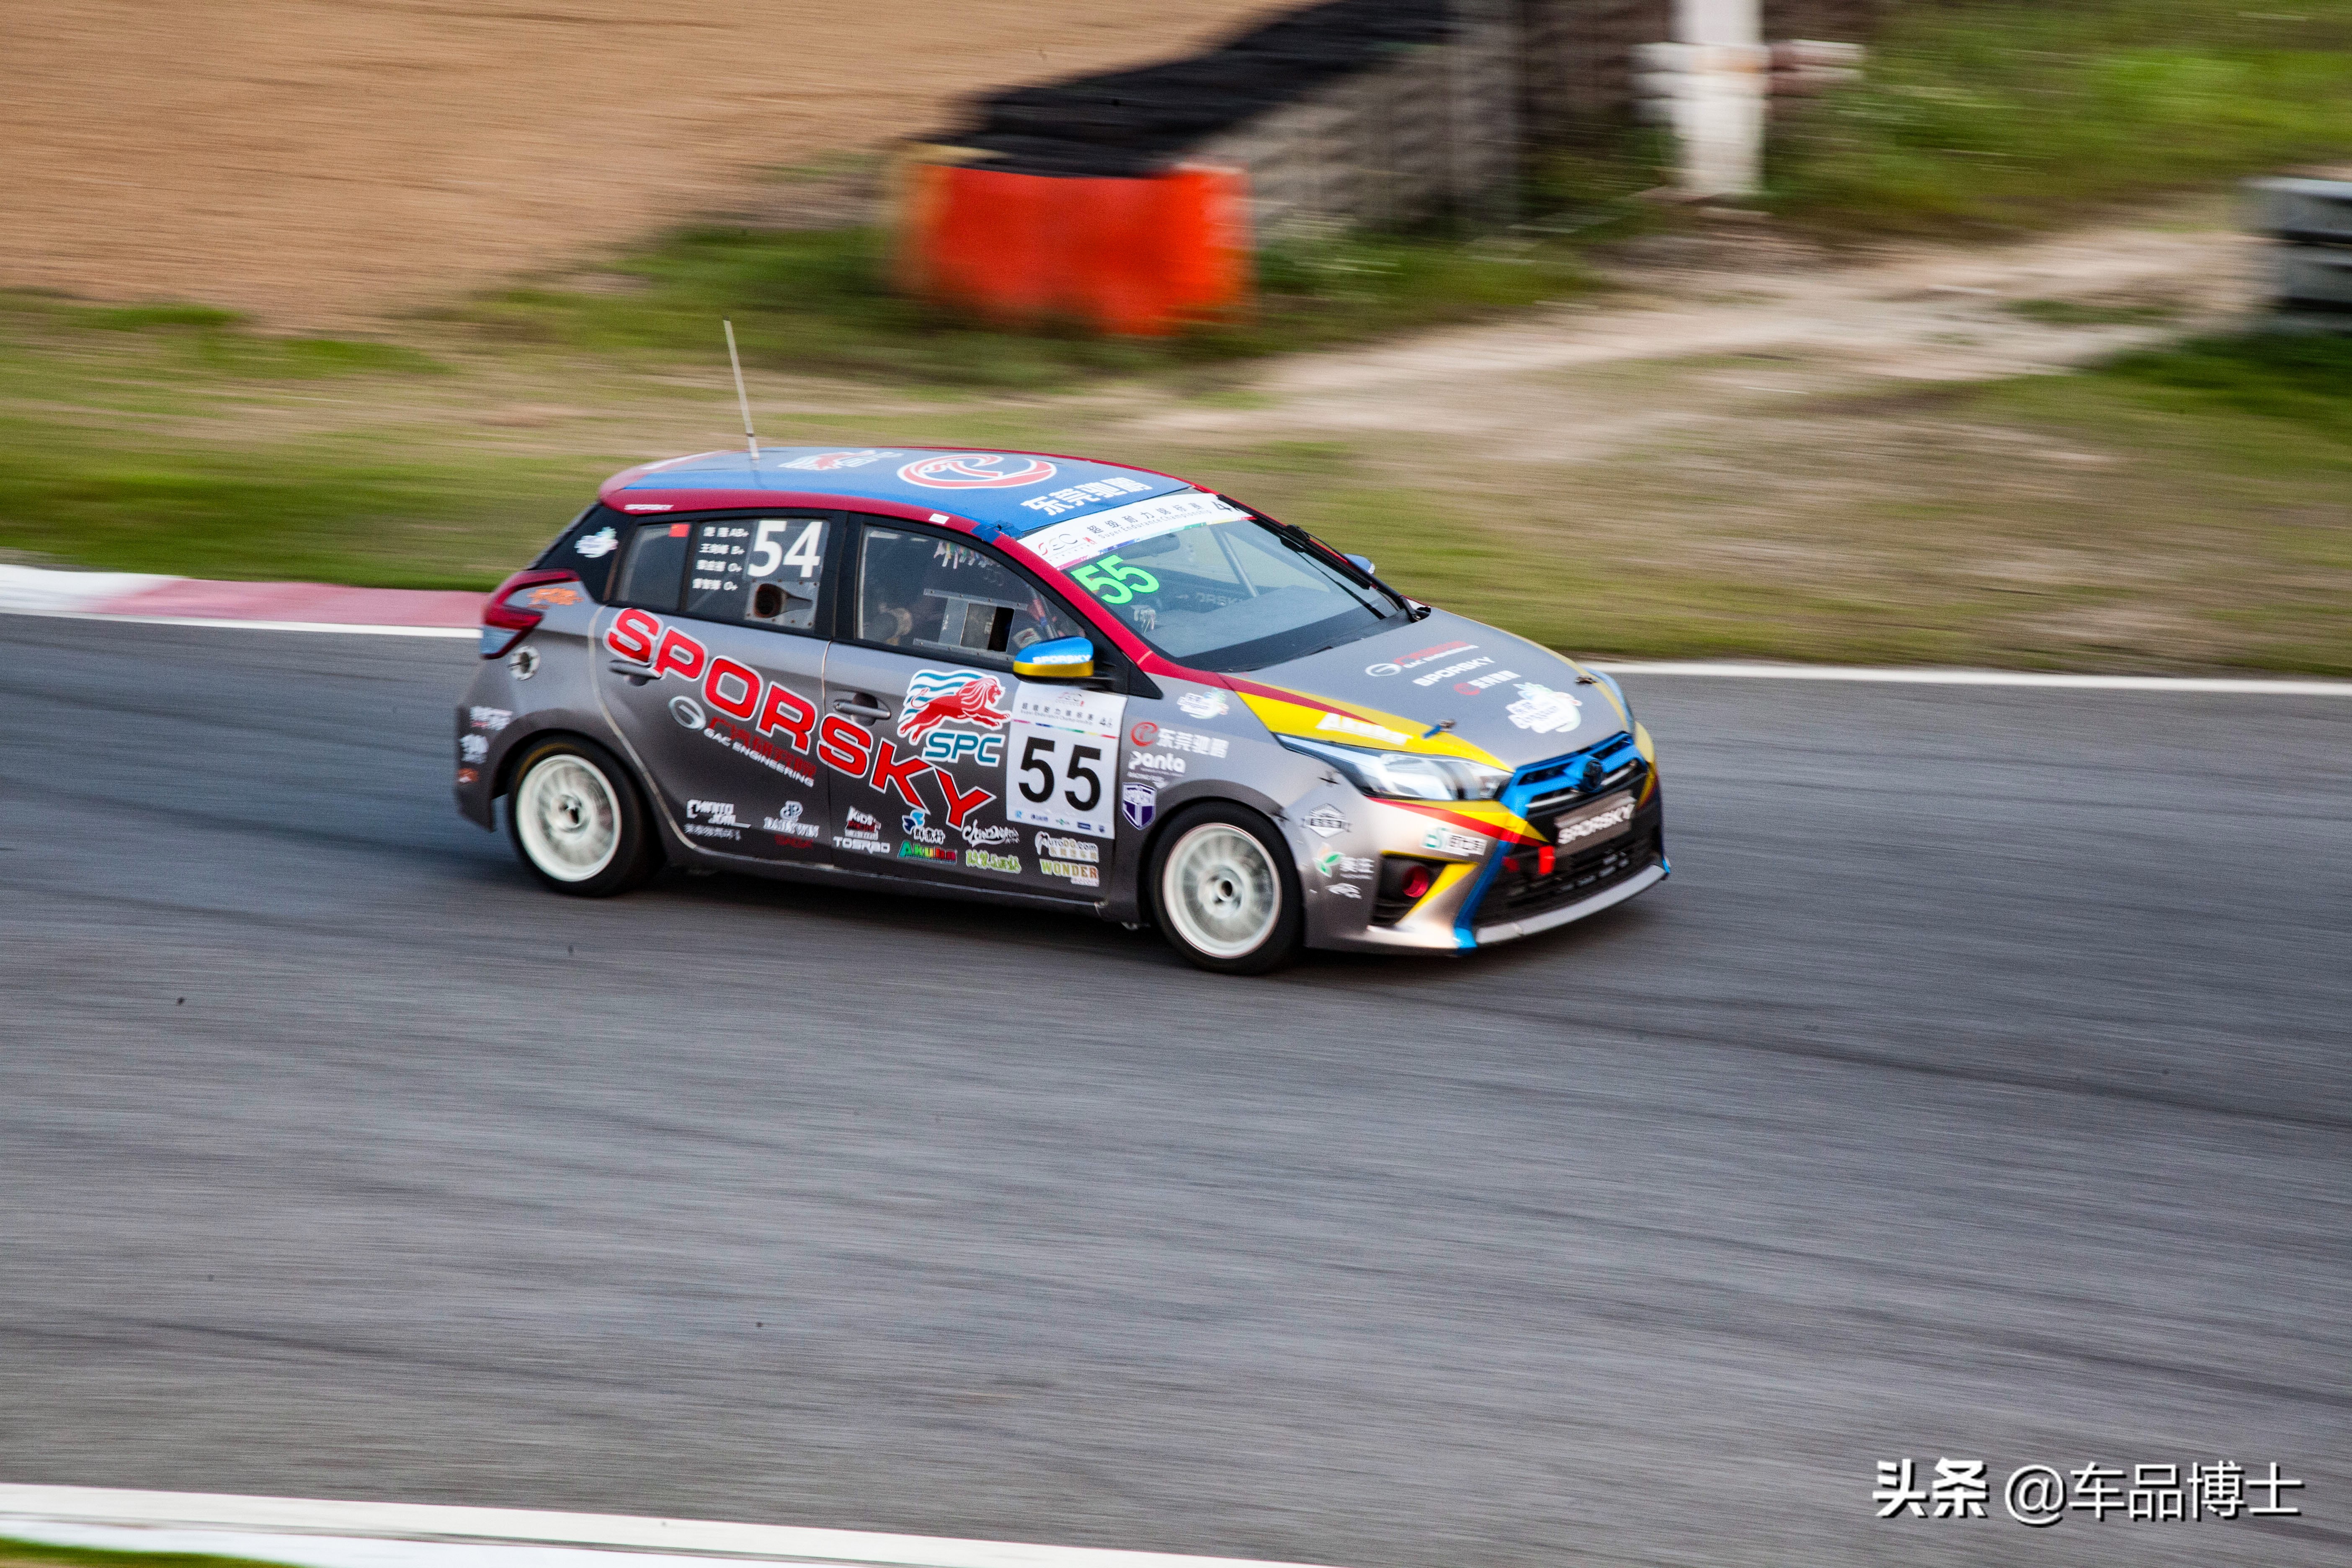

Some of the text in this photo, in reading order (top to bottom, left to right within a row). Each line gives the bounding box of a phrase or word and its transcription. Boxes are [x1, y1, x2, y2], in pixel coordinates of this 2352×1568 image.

[1020, 477, 1153, 516] 东莞驰鹏
[1098, 508, 1212, 539] Super Endurance Championship
[747, 521, 823, 578] 54
[1070, 554, 1160, 604] 55
[1032, 655, 1091, 664] SPORSKY
[1412, 656, 1496, 687] SPORSKY
[603, 607, 997, 831] SPORSKY
[704, 728, 815, 787] GAC ENGINEERING
[923, 729, 1005, 768] SPC
[1018, 737, 1101, 812] 55
[1558, 803, 1635, 844] SPORSKY
[1040, 859, 1098, 879] WONDER
